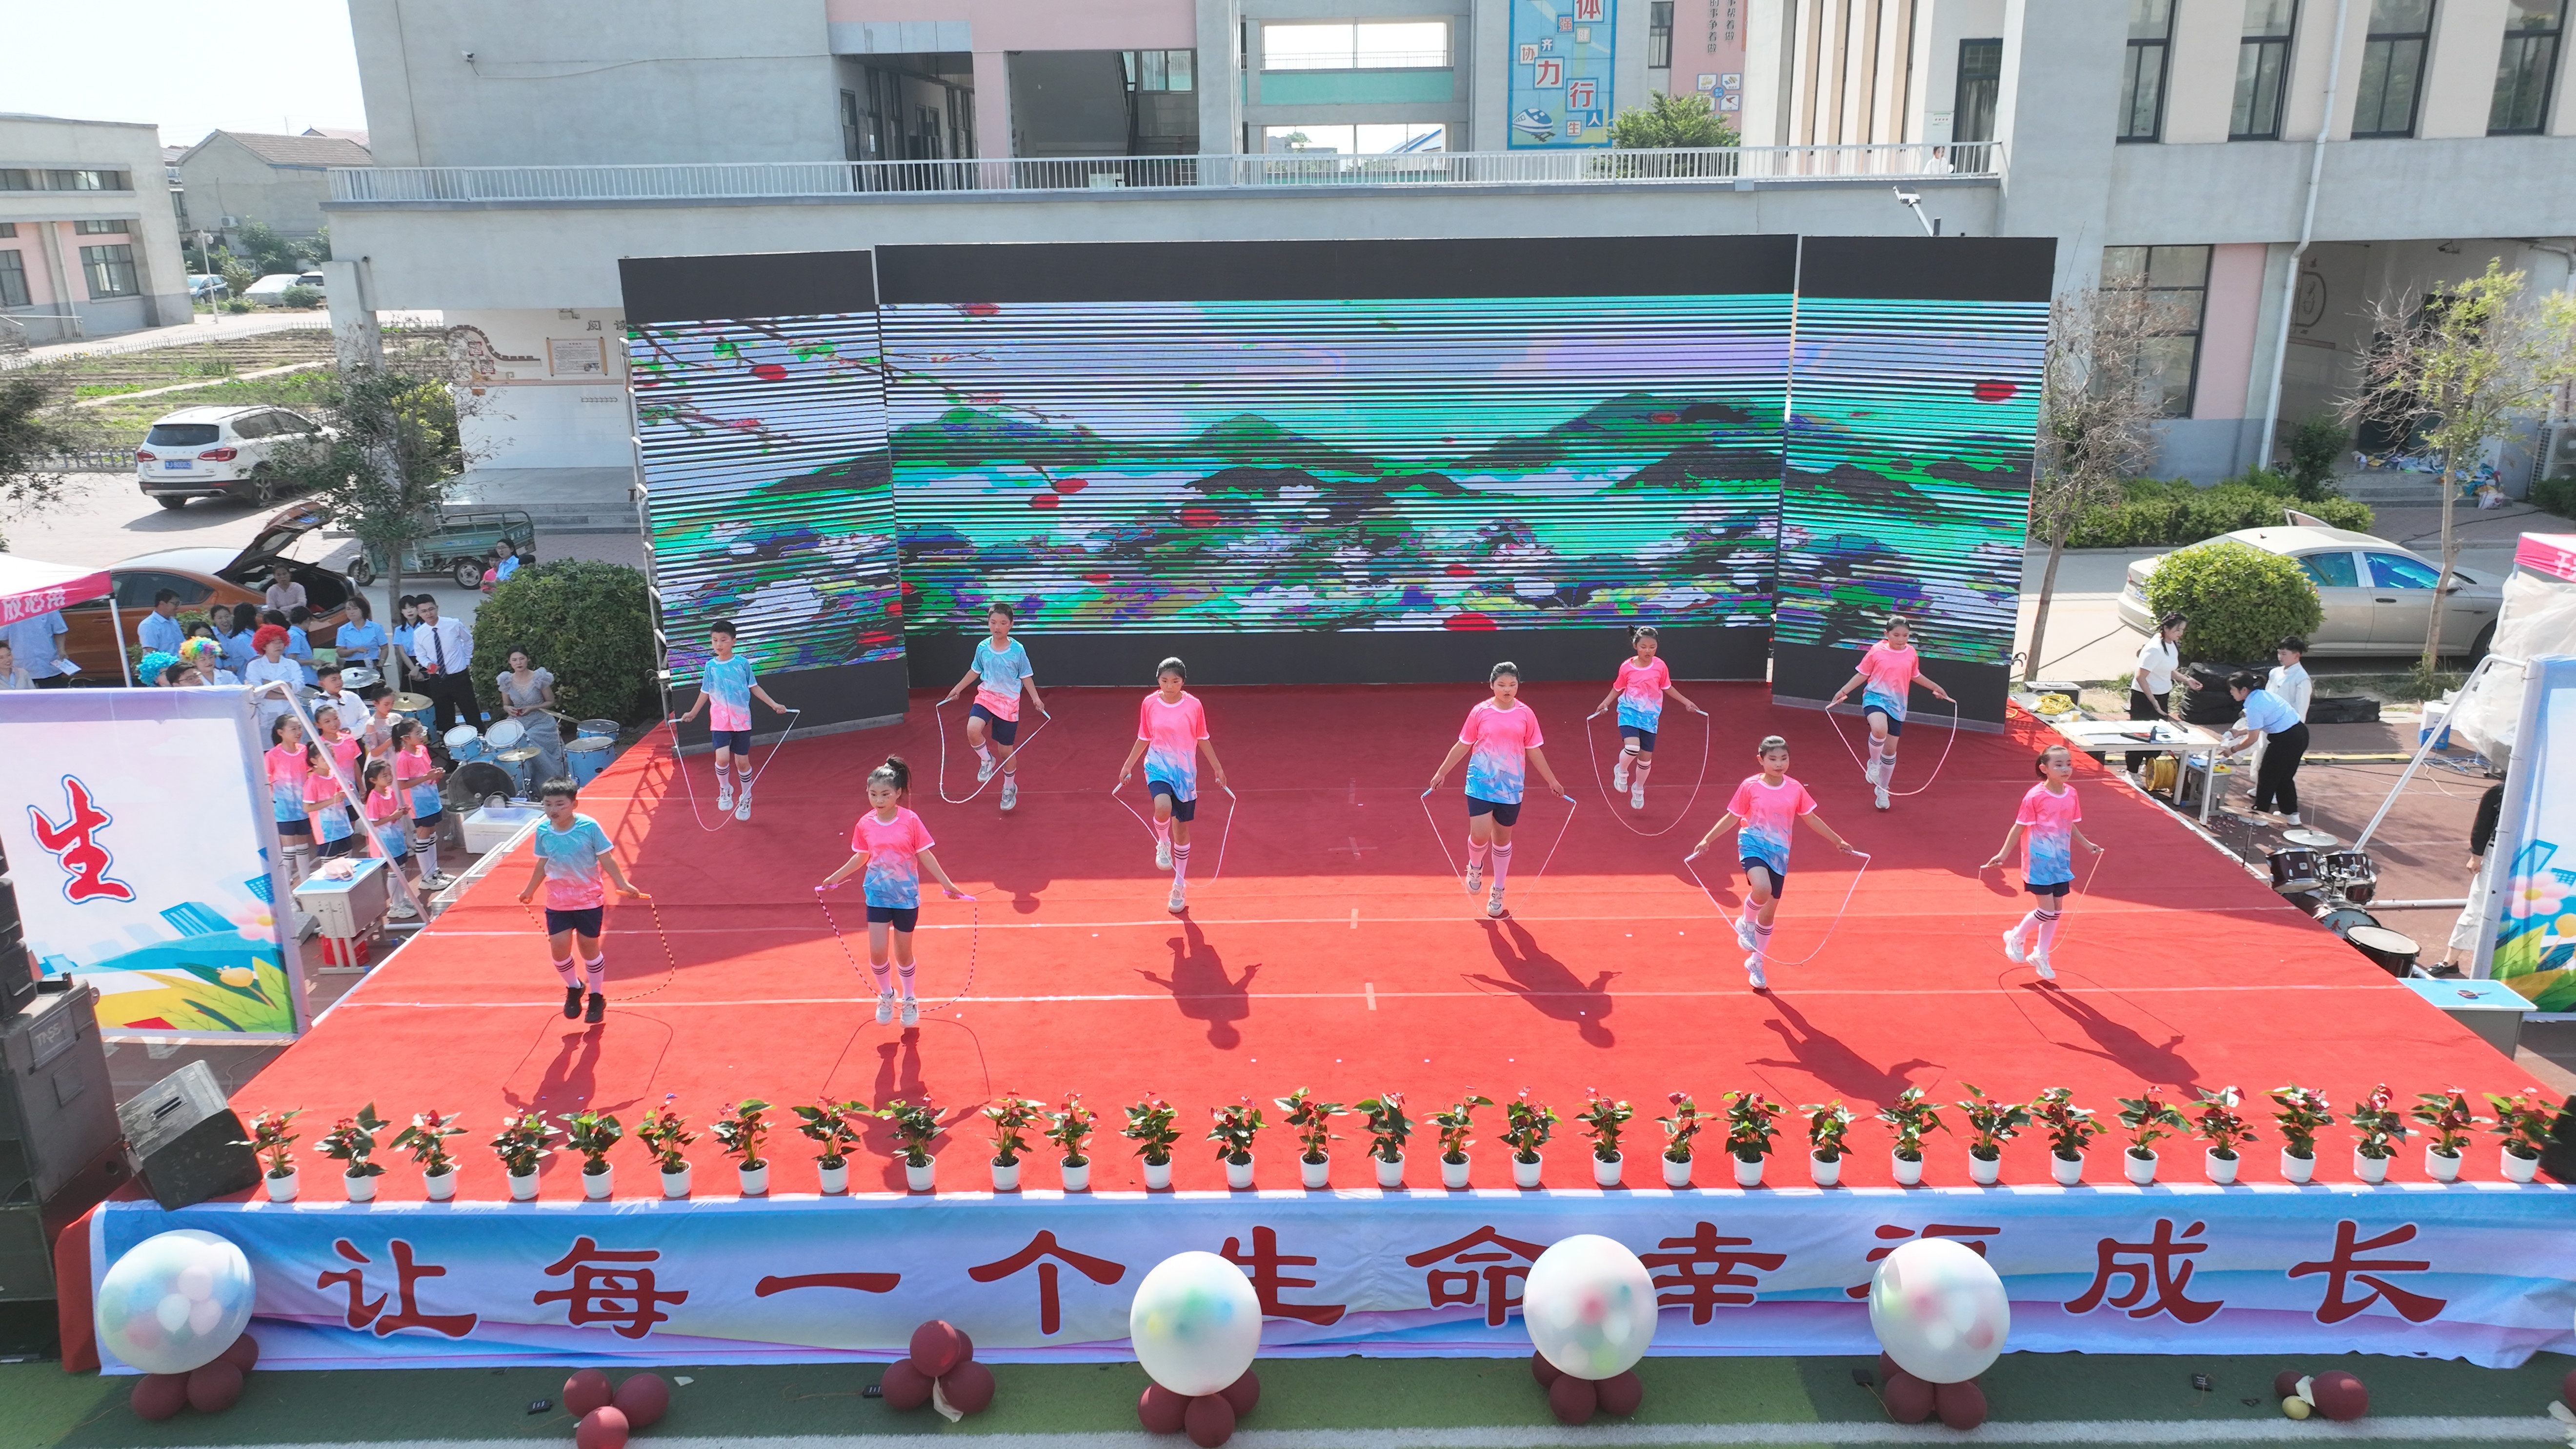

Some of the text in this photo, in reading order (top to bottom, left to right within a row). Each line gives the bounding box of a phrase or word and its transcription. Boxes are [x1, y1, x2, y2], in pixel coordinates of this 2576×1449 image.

[1576, 0, 1601, 19] 体
[1559, 18, 1572, 32] 强
[1578, 30, 1589, 41] 健
[1541, 39, 1552, 51] 齐
[1522, 47, 1535, 60] 协
[1537, 60, 1559, 85] 力
[1570, 82, 1594, 107] 行
[1588, 112, 1601, 126] 人
[1568, 122, 1579, 134] 生
[28, 775, 135, 904] 生
